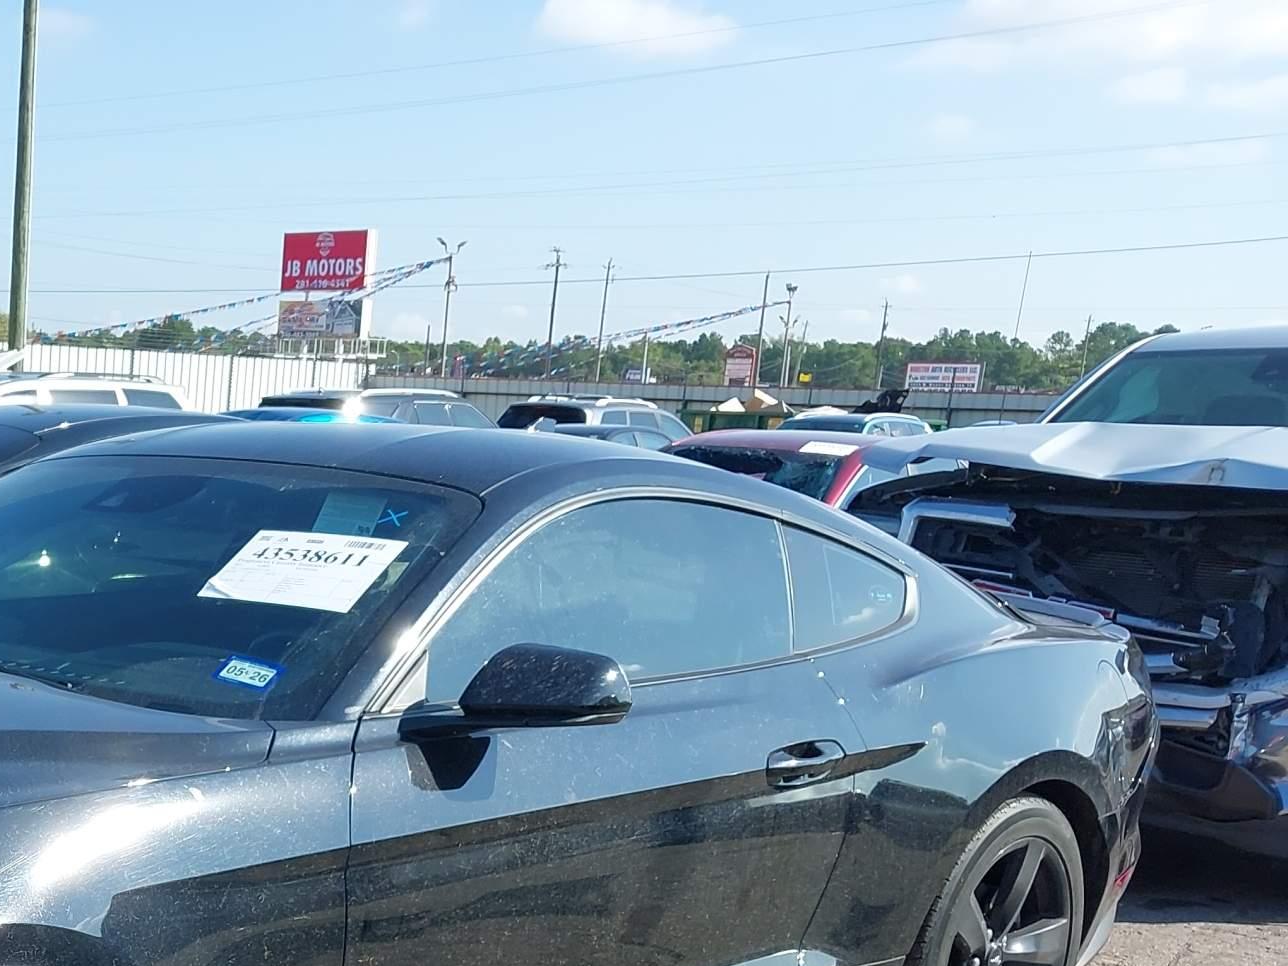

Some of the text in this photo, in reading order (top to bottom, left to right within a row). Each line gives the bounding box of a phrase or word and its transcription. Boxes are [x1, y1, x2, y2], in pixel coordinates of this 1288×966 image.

[284, 258, 363, 277] JB MOTORS
[252, 546, 370, 567] 43538611
